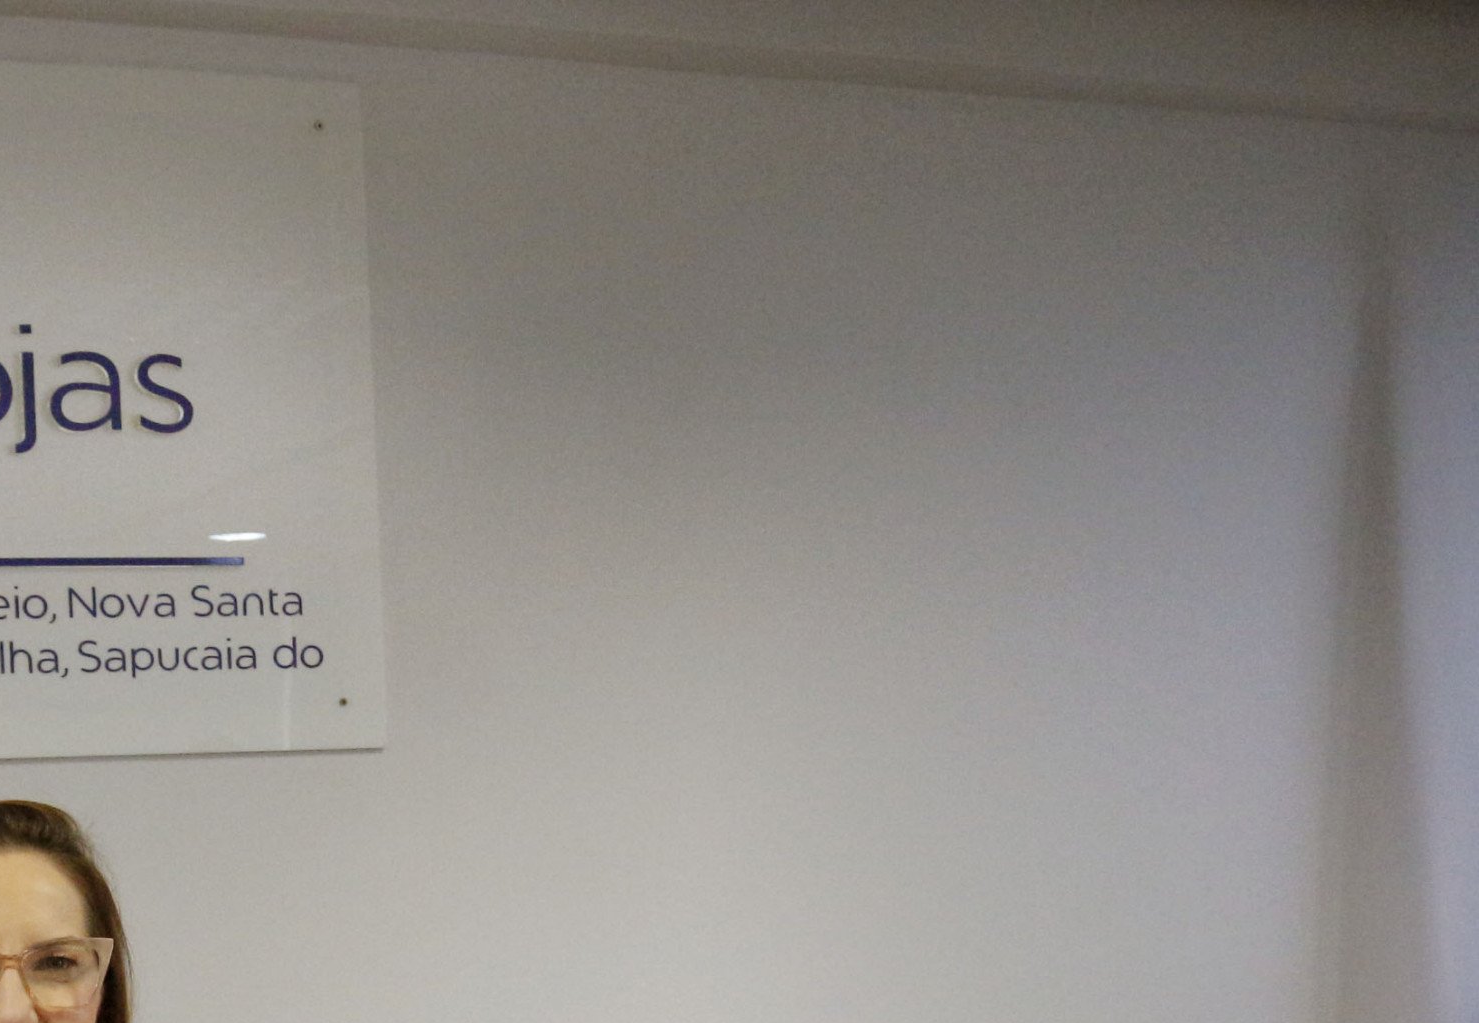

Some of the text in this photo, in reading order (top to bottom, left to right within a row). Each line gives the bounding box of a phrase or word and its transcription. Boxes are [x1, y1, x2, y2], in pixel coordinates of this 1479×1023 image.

[66, 586, 177, 620] Nova
[189, 583, 304, 619] Santa
[76, 638, 258, 679] Sapucaia
[271, 636, 325, 671] do
